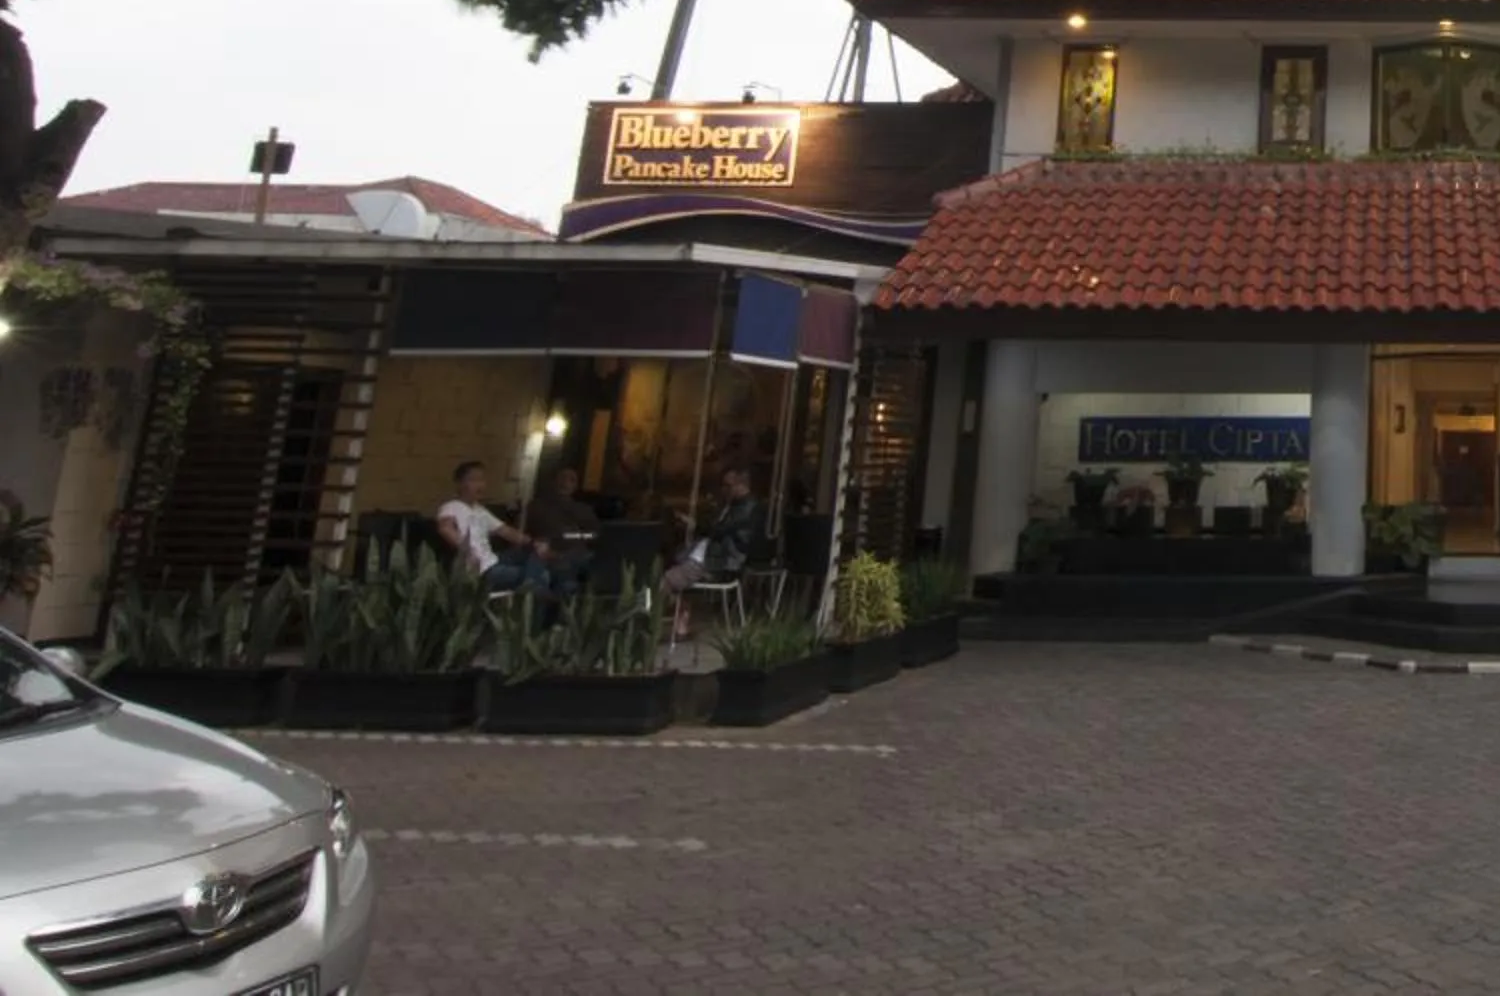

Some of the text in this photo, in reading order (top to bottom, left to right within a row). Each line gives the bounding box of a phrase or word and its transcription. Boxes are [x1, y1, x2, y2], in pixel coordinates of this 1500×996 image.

[617, 114, 792, 161] Blueberry
[612, 154, 786, 180] Pancake House
[1084, 421, 1305, 456] HOTEL CIPTA
